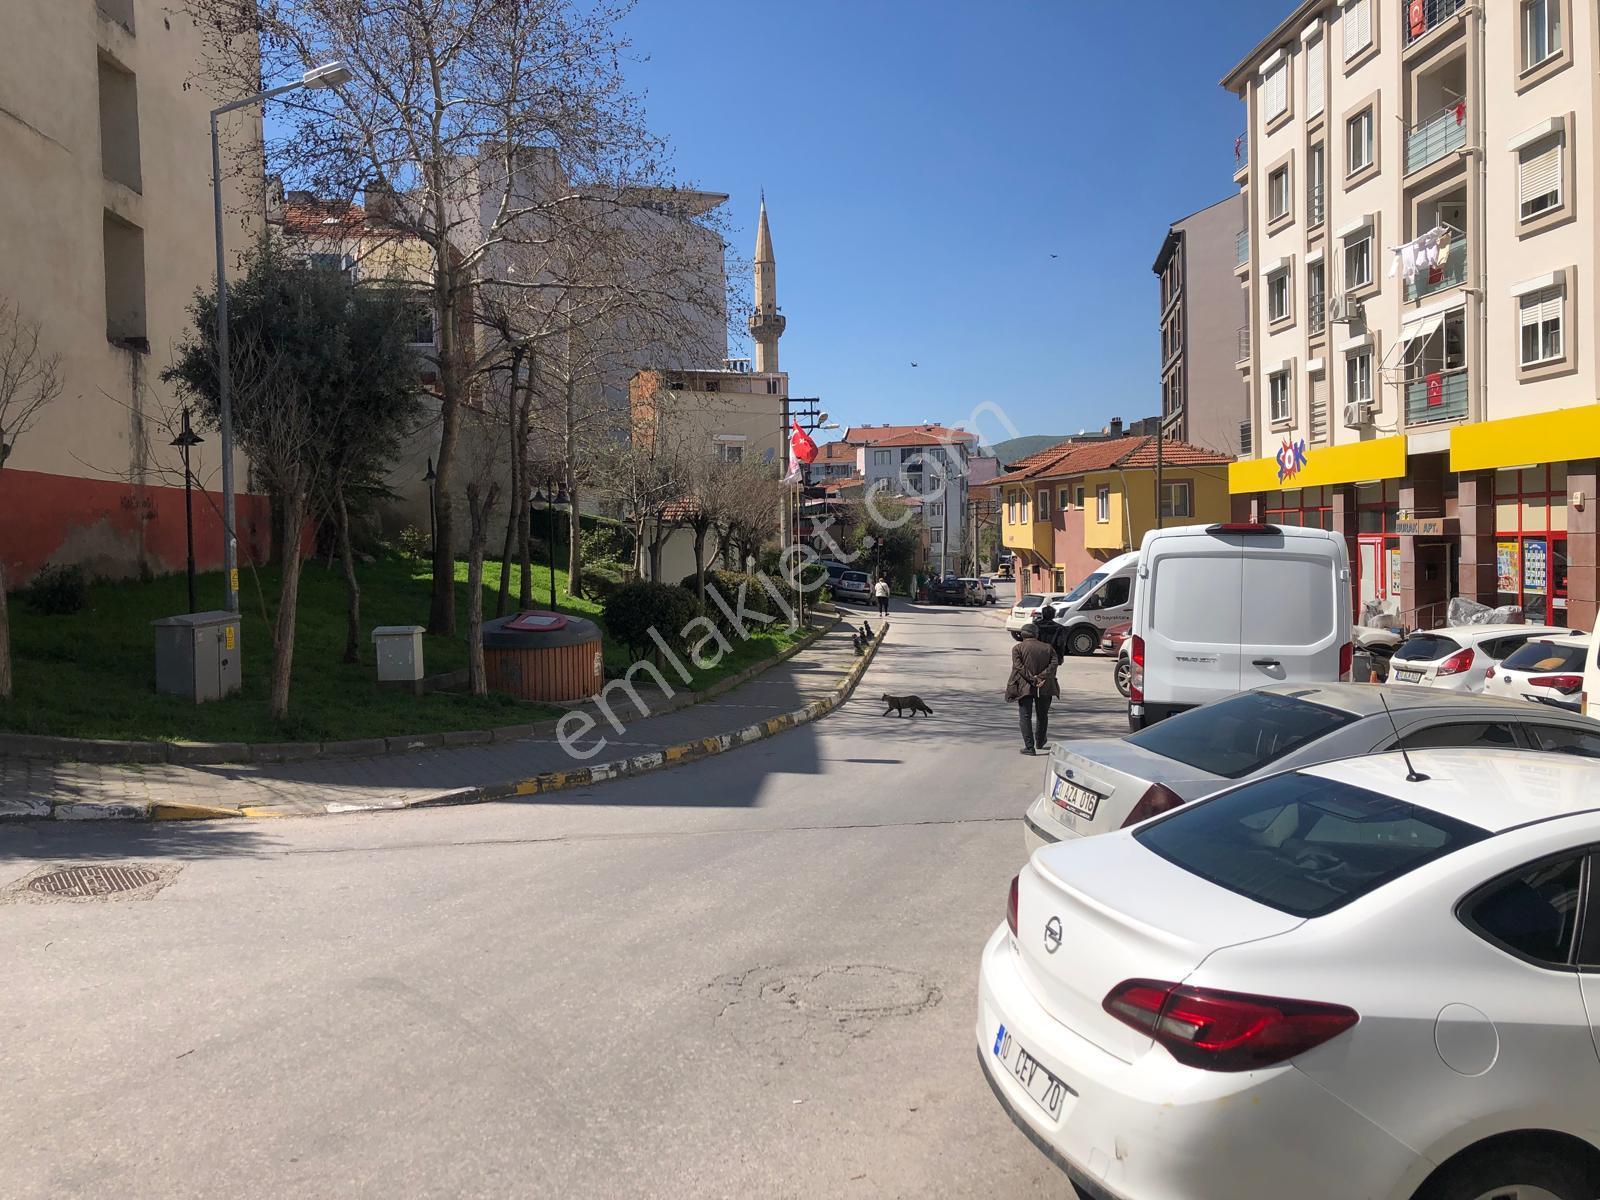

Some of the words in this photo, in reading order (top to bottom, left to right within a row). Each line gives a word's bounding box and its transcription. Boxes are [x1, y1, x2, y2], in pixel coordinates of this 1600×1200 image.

[1080, 791, 1096, 812] 016
[1001, 1031, 1012, 1060] 10
[1015, 1049, 1039, 1088] CEV
[1041, 1074, 1061, 1112] 70
